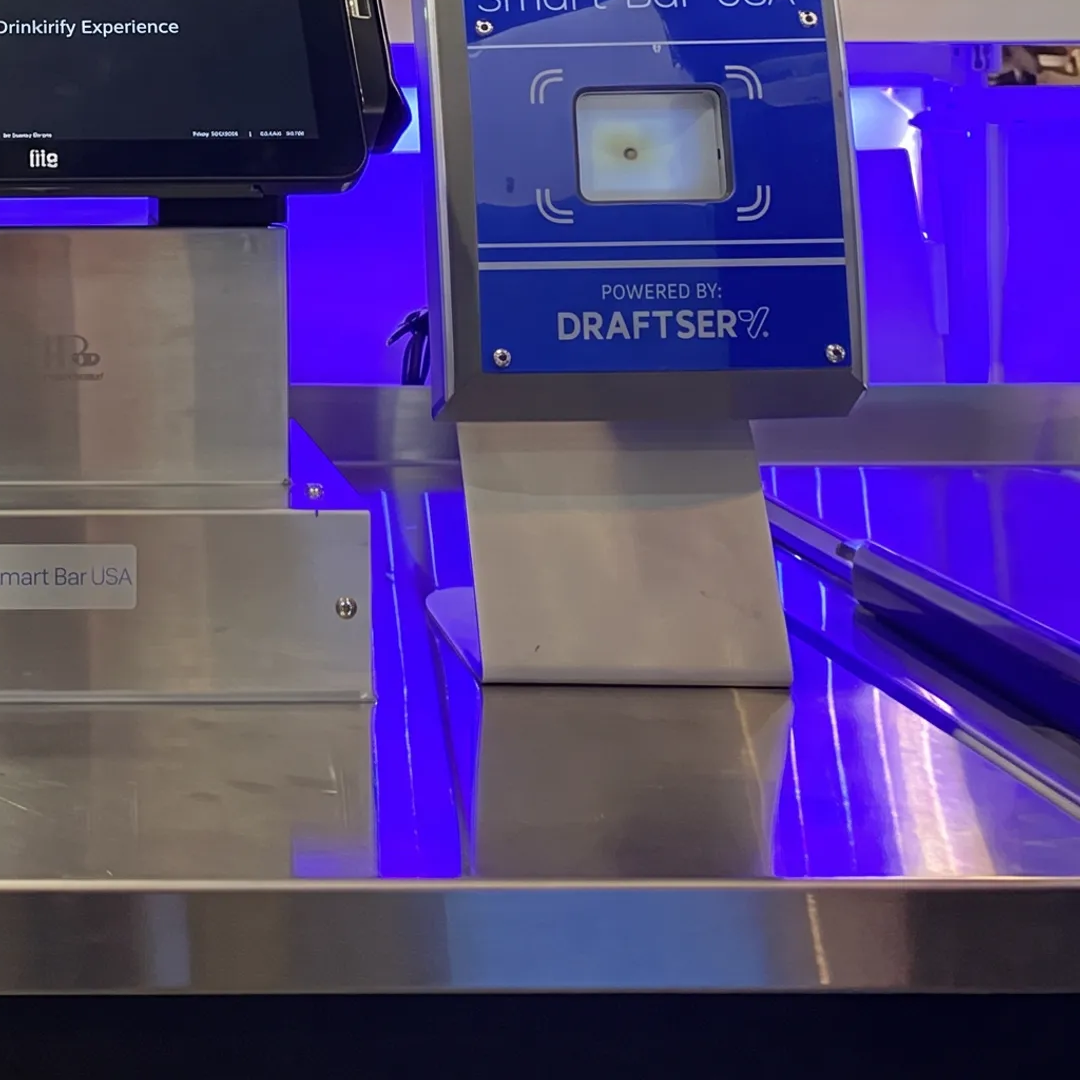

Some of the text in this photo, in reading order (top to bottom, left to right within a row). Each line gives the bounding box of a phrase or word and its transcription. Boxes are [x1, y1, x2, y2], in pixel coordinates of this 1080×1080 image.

[81, 19, 179, 37] Experience
[601, 282, 722, 300] POWERED BY:
[54, 567, 87, 586] Bar
[90, 567, 133, 586] USA
